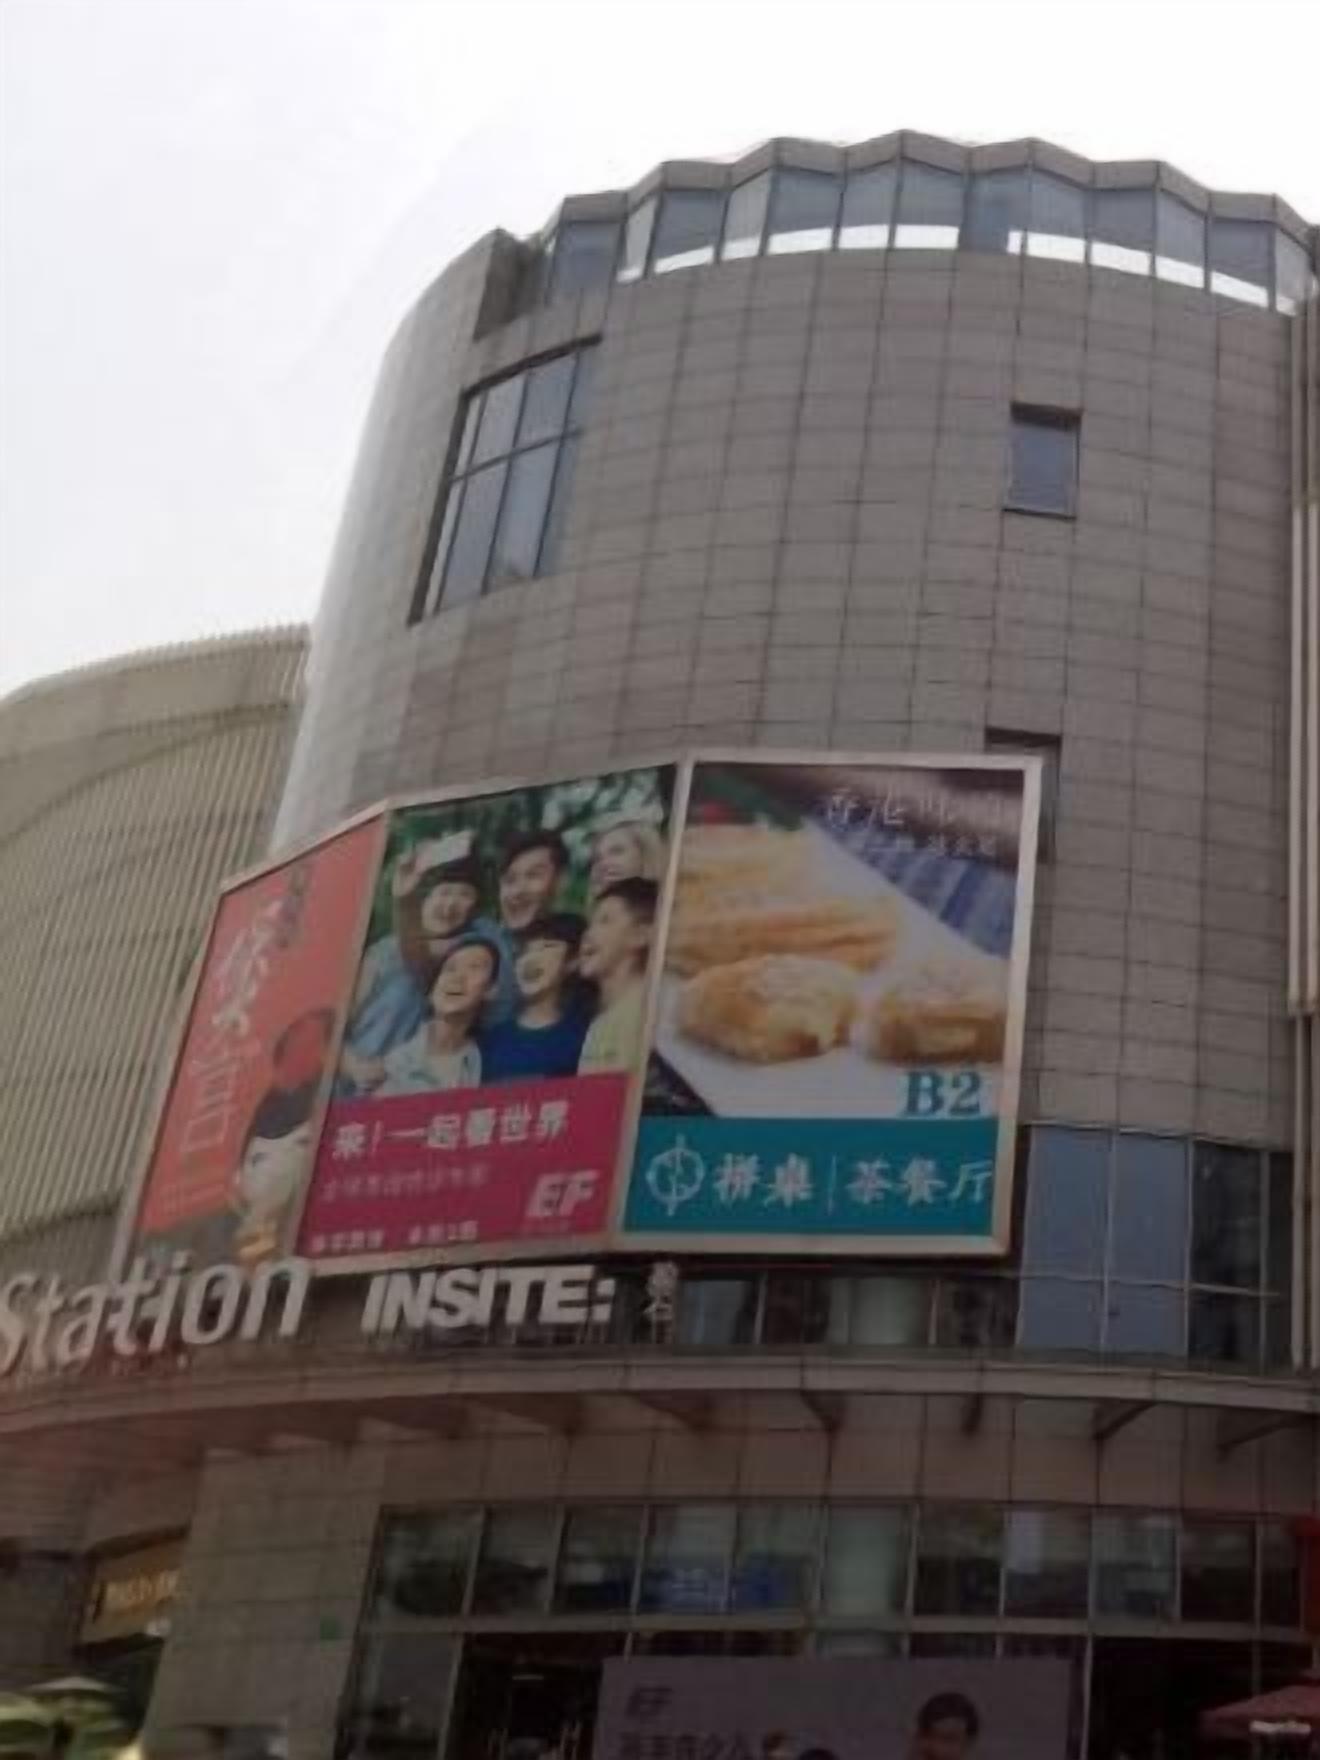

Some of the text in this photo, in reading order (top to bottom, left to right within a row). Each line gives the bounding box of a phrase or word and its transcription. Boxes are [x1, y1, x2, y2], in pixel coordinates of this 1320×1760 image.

[903, 1069, 985, 1118] B2
[526, 1169, 601, 1218] EF
[844, 1156, 993, 1207] 茶餐厅
[0, 1248, 311, 1376] Station
